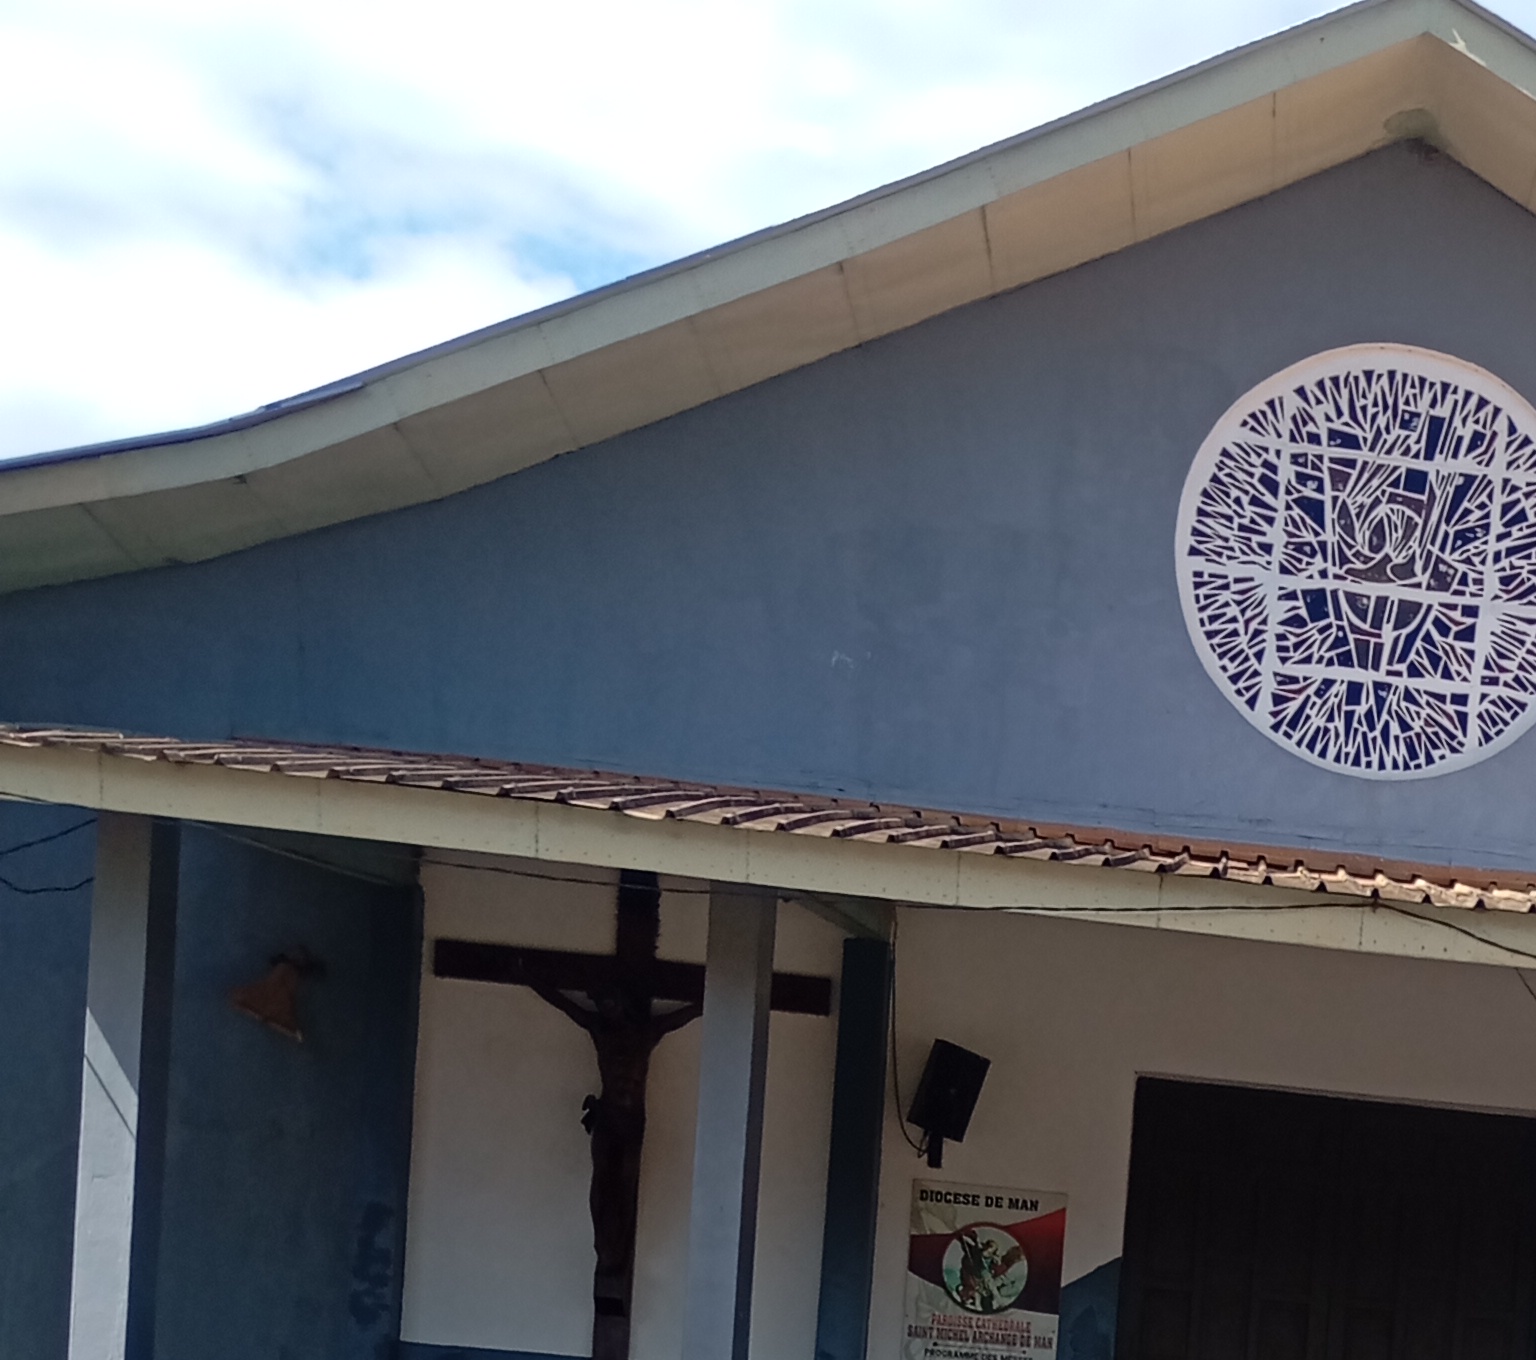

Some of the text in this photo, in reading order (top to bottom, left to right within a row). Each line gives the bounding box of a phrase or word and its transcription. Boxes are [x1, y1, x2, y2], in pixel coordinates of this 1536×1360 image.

[919, 1189, 1039, 1211] DIOCESE DE MAN
[907, 1324, 1054, 1349] SAINT MICHEL ARCHANGE DE MAN
[924, 1348, 980, 1360] PROGRAMME
